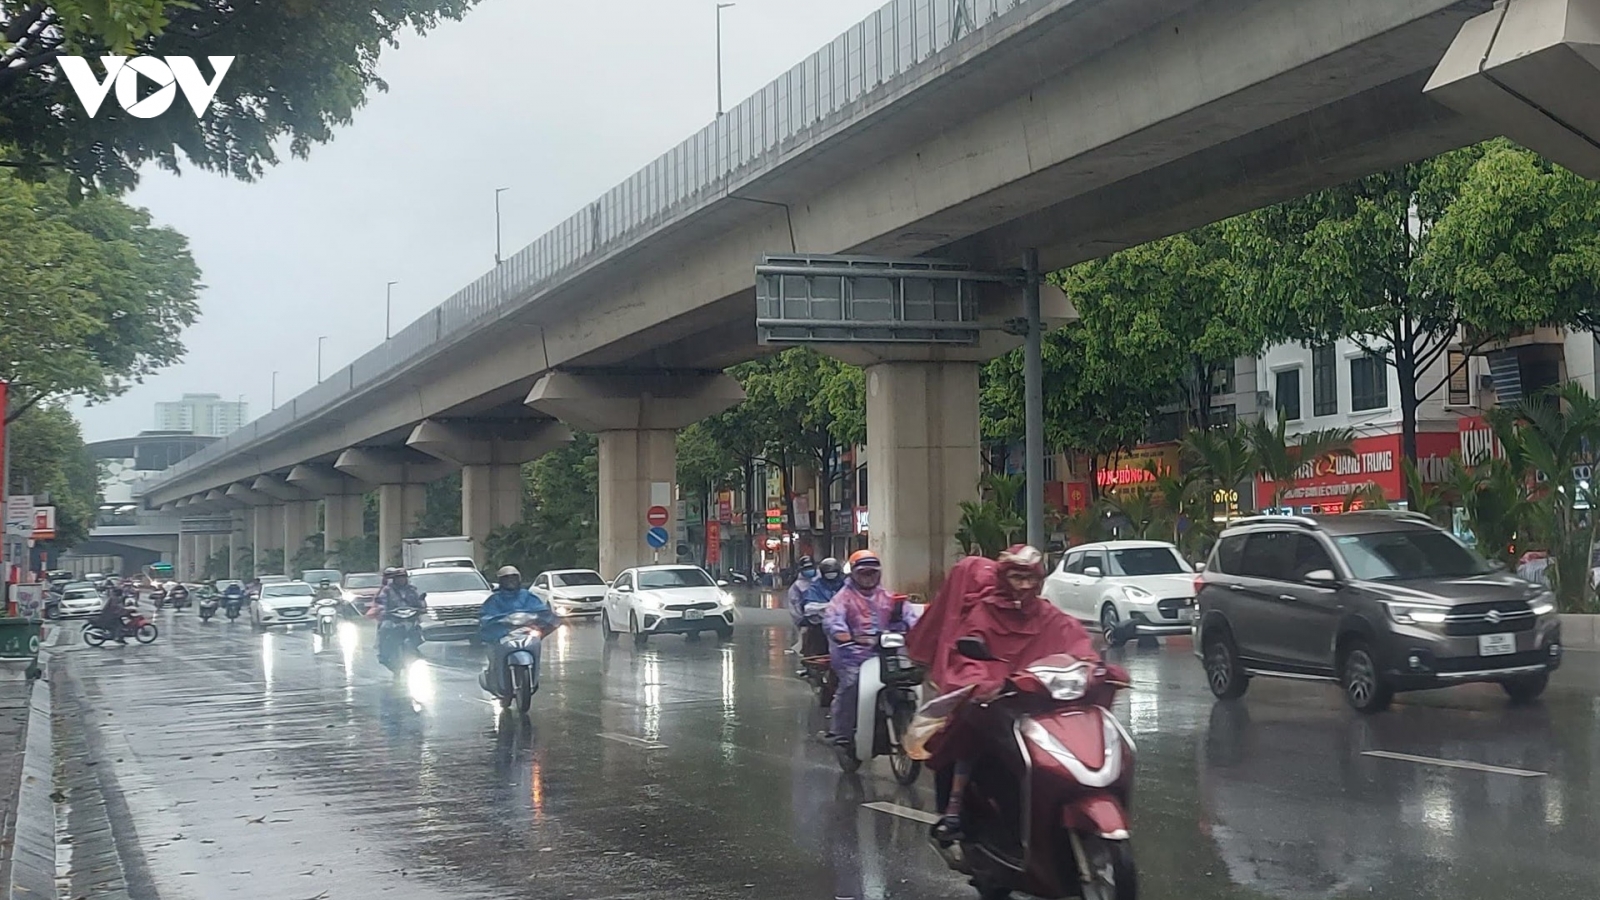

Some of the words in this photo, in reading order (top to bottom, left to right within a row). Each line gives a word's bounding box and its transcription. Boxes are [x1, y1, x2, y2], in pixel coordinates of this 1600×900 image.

[1461, 421, 1493, 467] KÍNH
[1315, 454, 1361, 476] QUANG
[1361, 450, 1393, 473] TRUNG
[1417, 453, 1455, 483] KÍN
